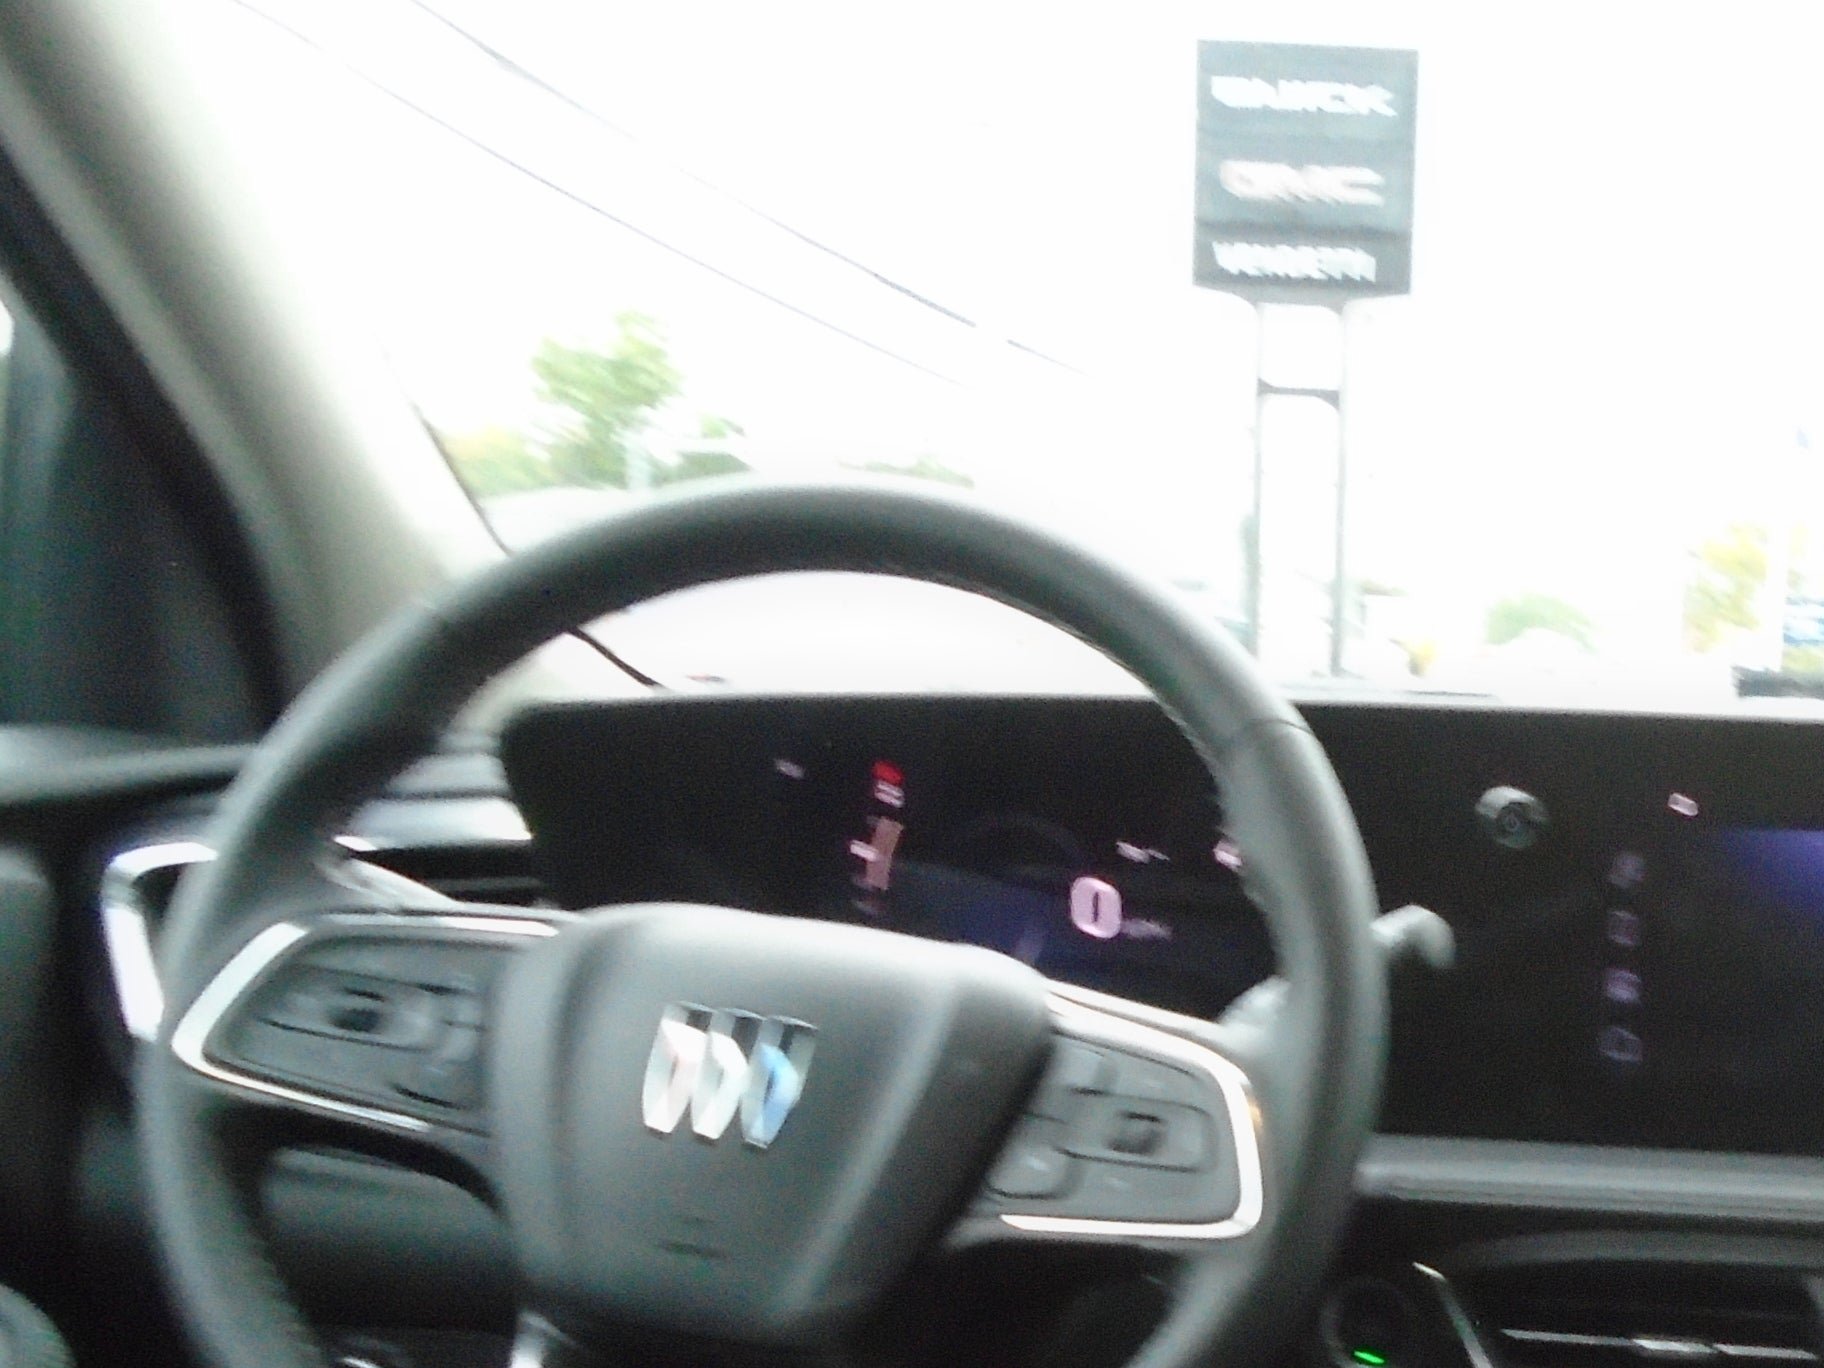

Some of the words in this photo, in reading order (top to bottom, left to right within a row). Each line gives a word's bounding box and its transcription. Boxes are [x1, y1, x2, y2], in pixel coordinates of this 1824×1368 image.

[1211, 75, 1397, 117] BUICK
[1219, 159, 1385, 206] GMC
[1070, 877, 1122, 940] 0
